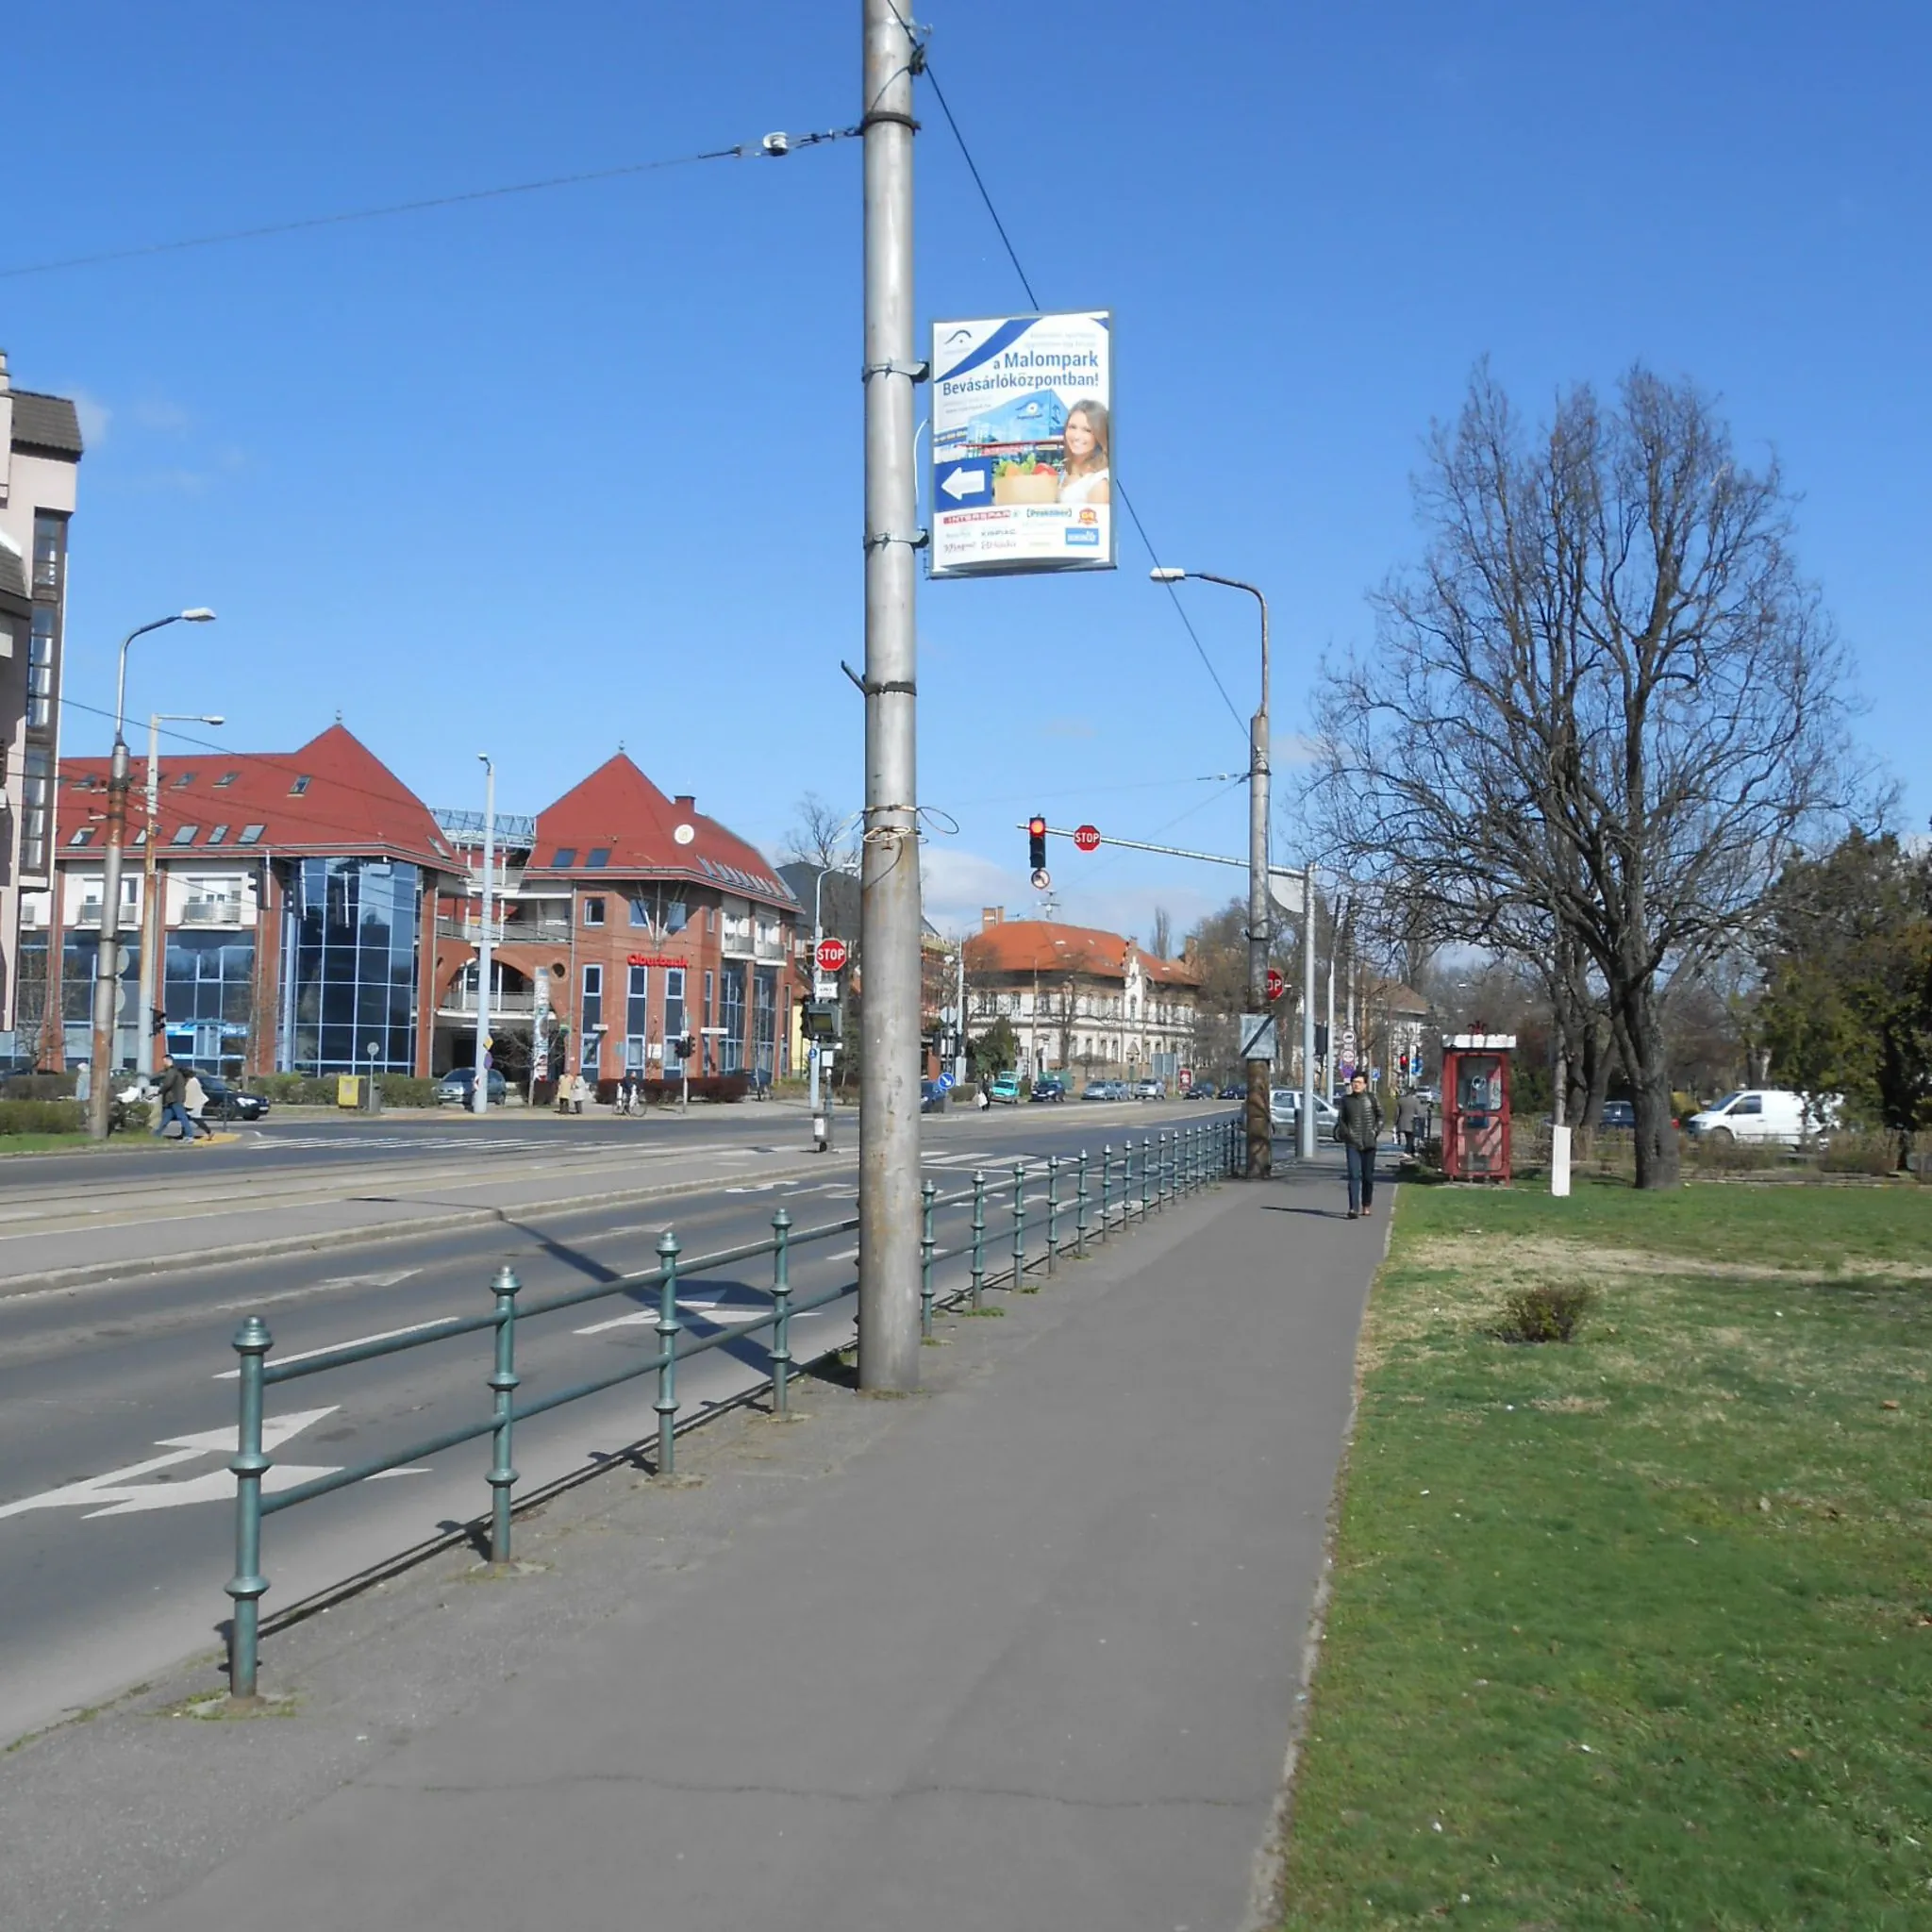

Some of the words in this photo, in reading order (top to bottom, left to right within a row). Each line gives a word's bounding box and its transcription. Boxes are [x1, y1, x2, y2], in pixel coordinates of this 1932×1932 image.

[993, 359, 1001, 370] a
[1004, 350, 1099, 371] Malompark
[1075, 832, 1099, 842] STOP
[818, 948, 844, 960] STOP
